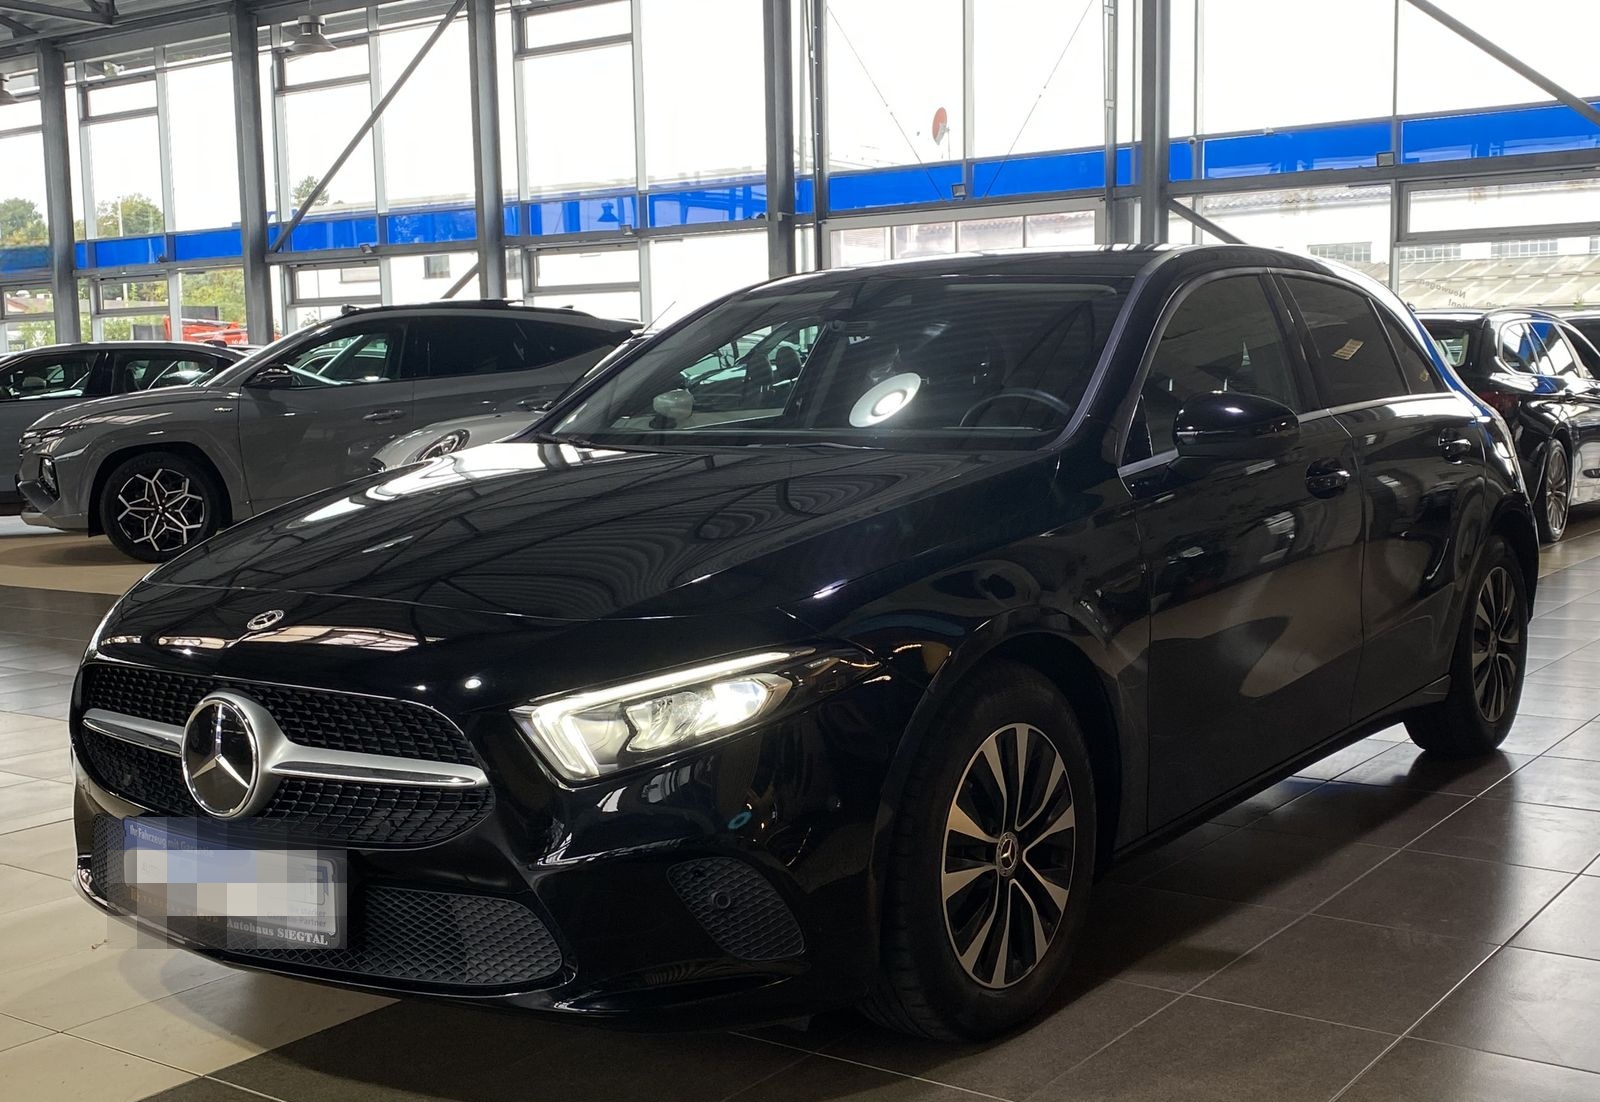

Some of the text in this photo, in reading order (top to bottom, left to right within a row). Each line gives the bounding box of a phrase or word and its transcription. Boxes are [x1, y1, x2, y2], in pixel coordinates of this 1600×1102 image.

[129, 825, 215, 858] Ihr Fahrzeug mit Garantie
[300, 908, 326, 918] starker
[227, 918, 328, 945] Autohaus SIEGTAL
